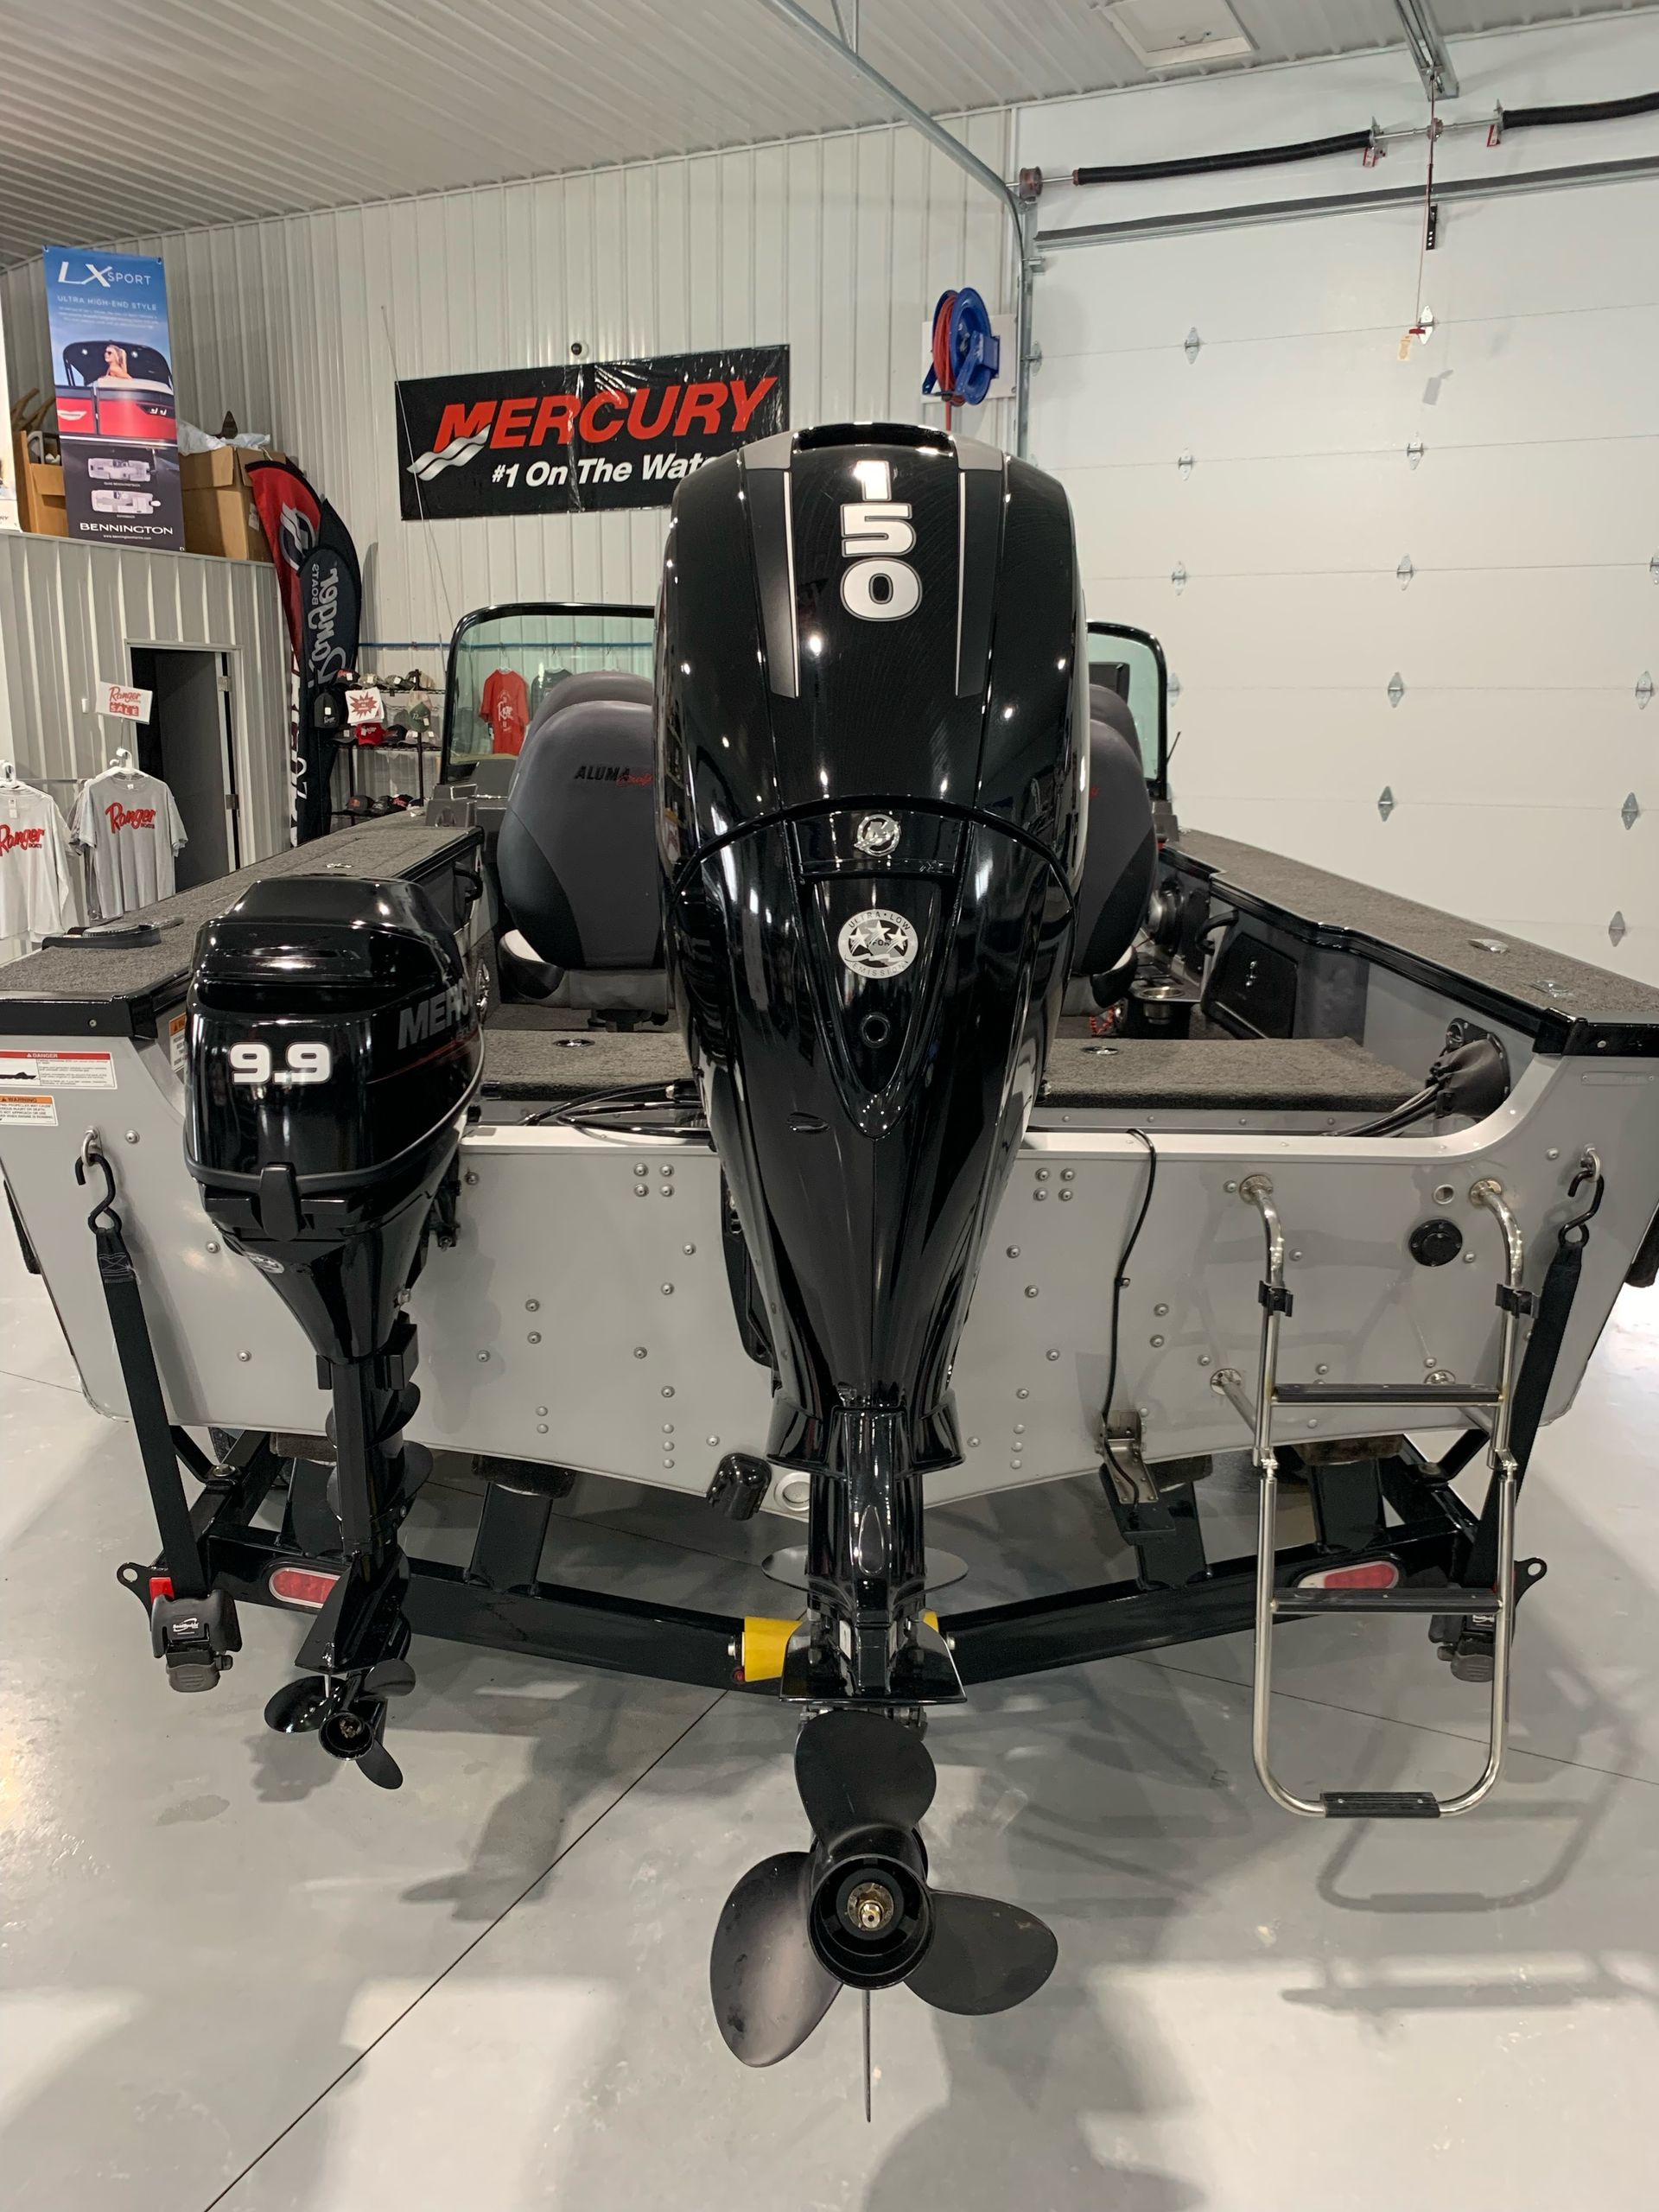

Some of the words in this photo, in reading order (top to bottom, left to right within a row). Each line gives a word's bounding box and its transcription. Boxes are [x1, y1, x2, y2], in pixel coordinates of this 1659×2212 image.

[57, 296, 85, 304] ULTRA
[87, 296, 129, 308] HIGH-END
[434, 377, 778, 453] MERCURY
[492, 462, 520, 488] #1
[525, 460, 567, 486] On
[577, 458, 632, 482] The
[642, 452, 720, 480] Wat
[79, 522, 174, 536] BENNINGTON
[840, 460, 923, 622] 150
[109, 686, 142, 703] Ranger
[110, 705, 138, 716] SALE
[105, 802, 156, 835] Ranger
[229, 1041, 332, 1084] 9.9
